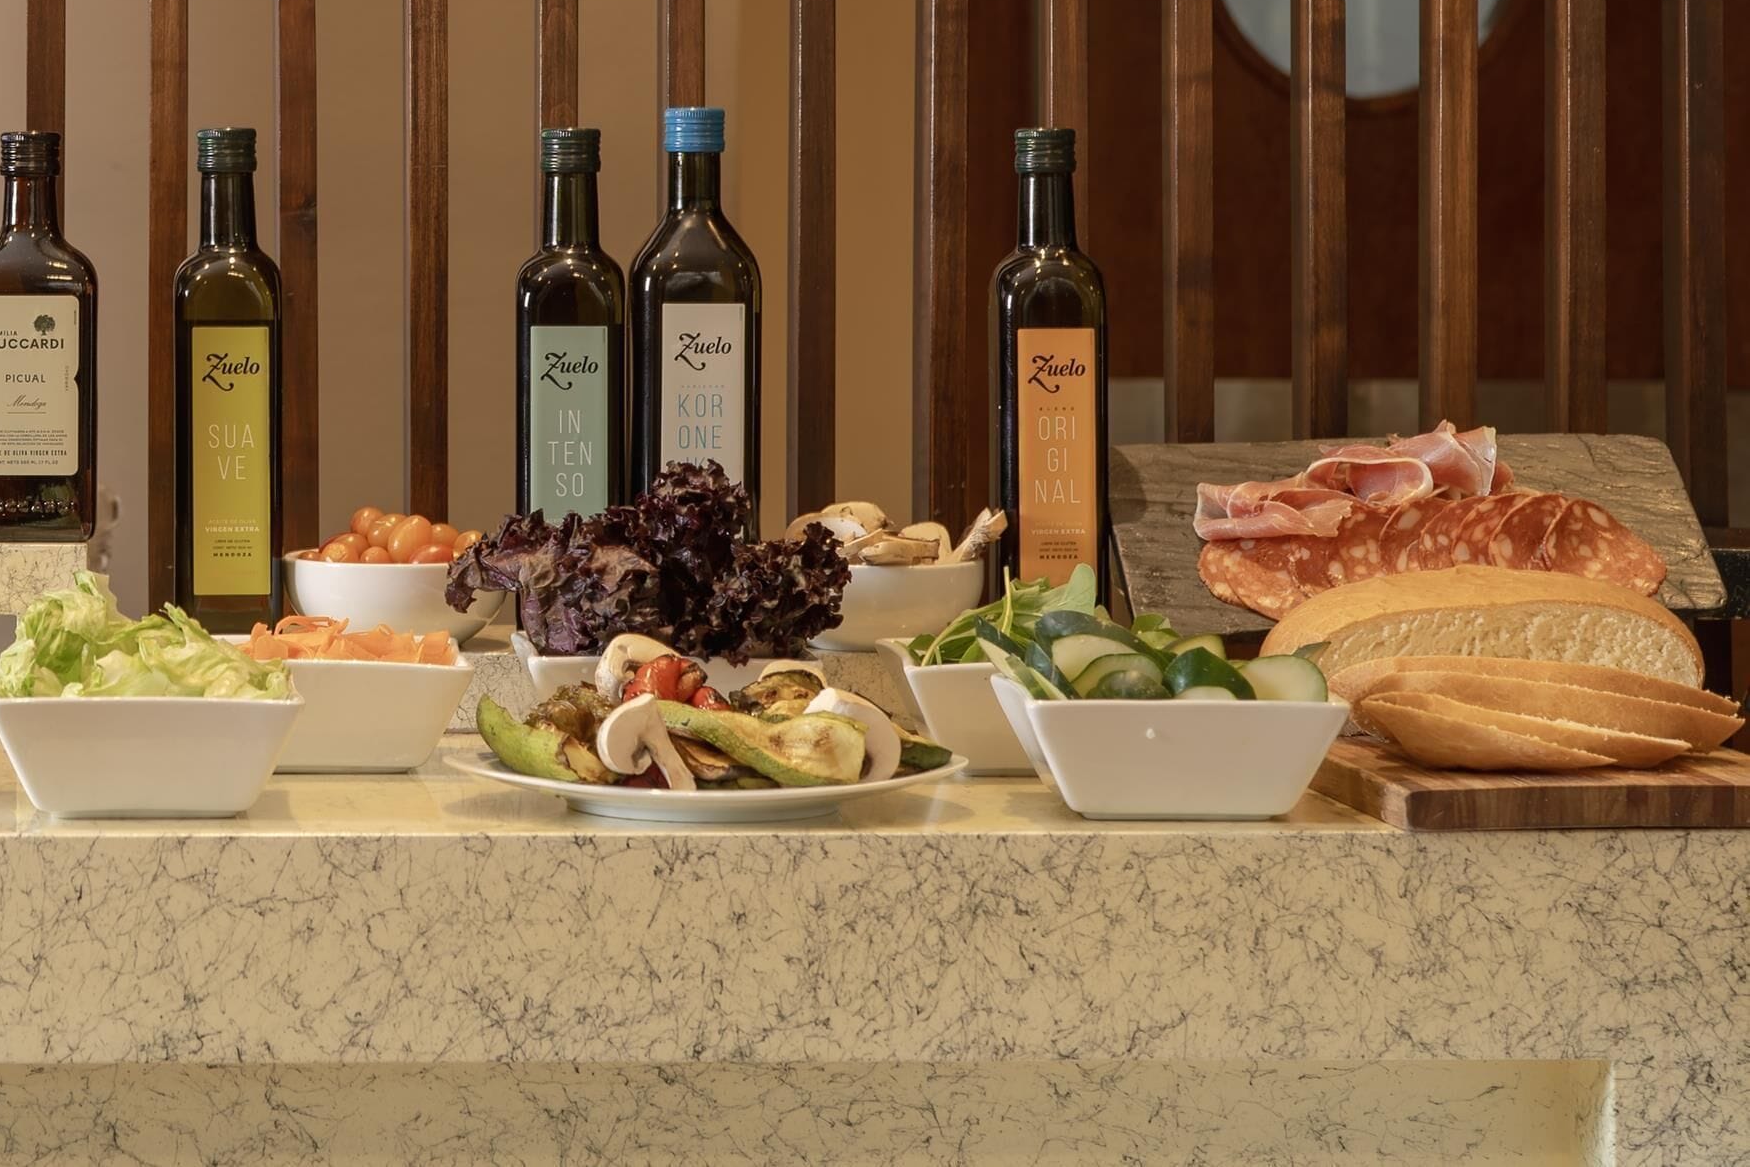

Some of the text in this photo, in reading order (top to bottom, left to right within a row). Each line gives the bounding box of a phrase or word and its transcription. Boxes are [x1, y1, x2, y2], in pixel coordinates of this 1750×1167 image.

[674, 332, 732, 371] Zuelo
[5, 374, 46, 383] PICUAL
[202, 353, 260, 391] Zuelo
[540, 352, 599, 391] Zuelo
[1028, 354, 1086, 394] Zuelo
[6, 394, 47, 410] Mendoza
[678, 394, 722, 418] KOR
[559, 410, 581, 434] IN
[1038, 416, 1075, 441] ORI
[208, 424, 255, 449] SUA
[679, 425, 722, 449] ONE
[548, 441, 593, 466] TEN
[1047, 447, 1067, 472] GI
[217, 455, 246, 480] VE
[555, 472, 584, 497] SO
[1035, 479, 1081, 504] NAL
